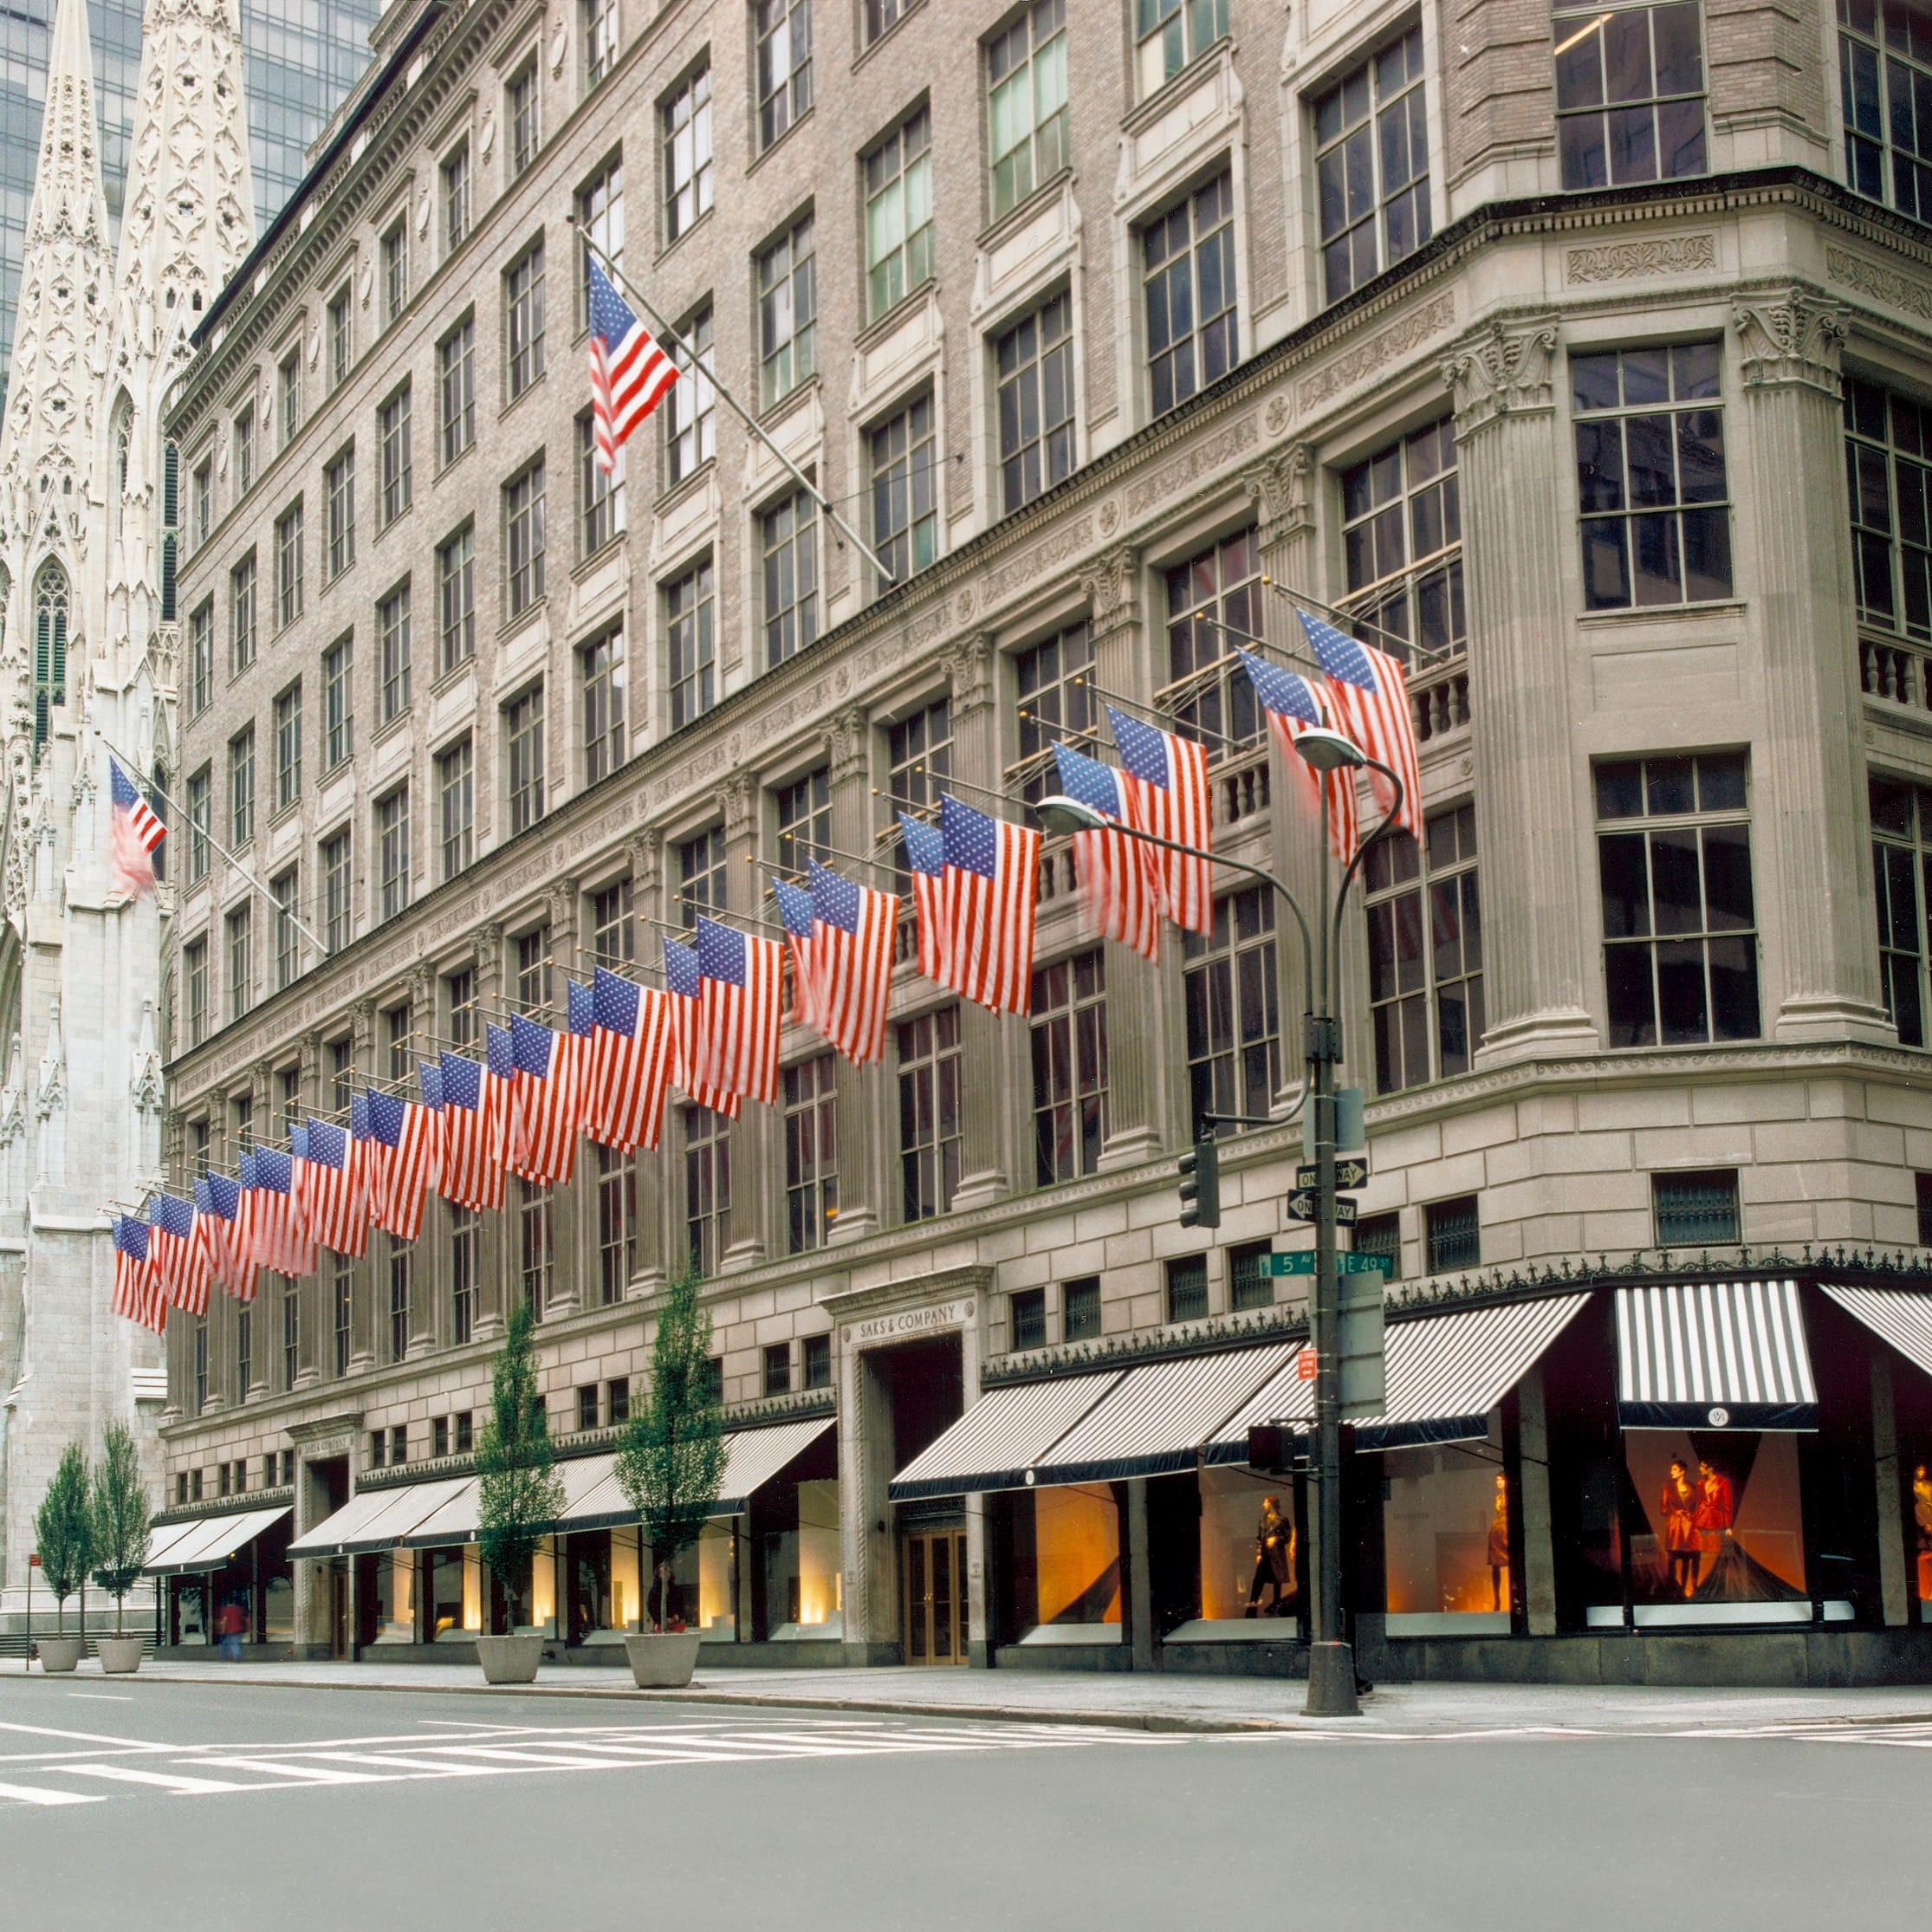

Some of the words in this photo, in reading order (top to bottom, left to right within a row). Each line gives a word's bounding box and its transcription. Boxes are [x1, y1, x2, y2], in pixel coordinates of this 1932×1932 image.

[1335, 1205, 1351, 1217] AY
[1283, 1256, 1294, 1273] 5
[1301, 1254, 1312, 1264] AV
[1348, 1256, 1356, 1272] E
[1361, 1256, 1378, 1272] 49
[1380, 1258, 1390, 1267] ST
[860, 1319, 885, 1338] SAKS
[888, 1319, 895, 1332] &
[898, 1305, 956, 1331] COMPANY
